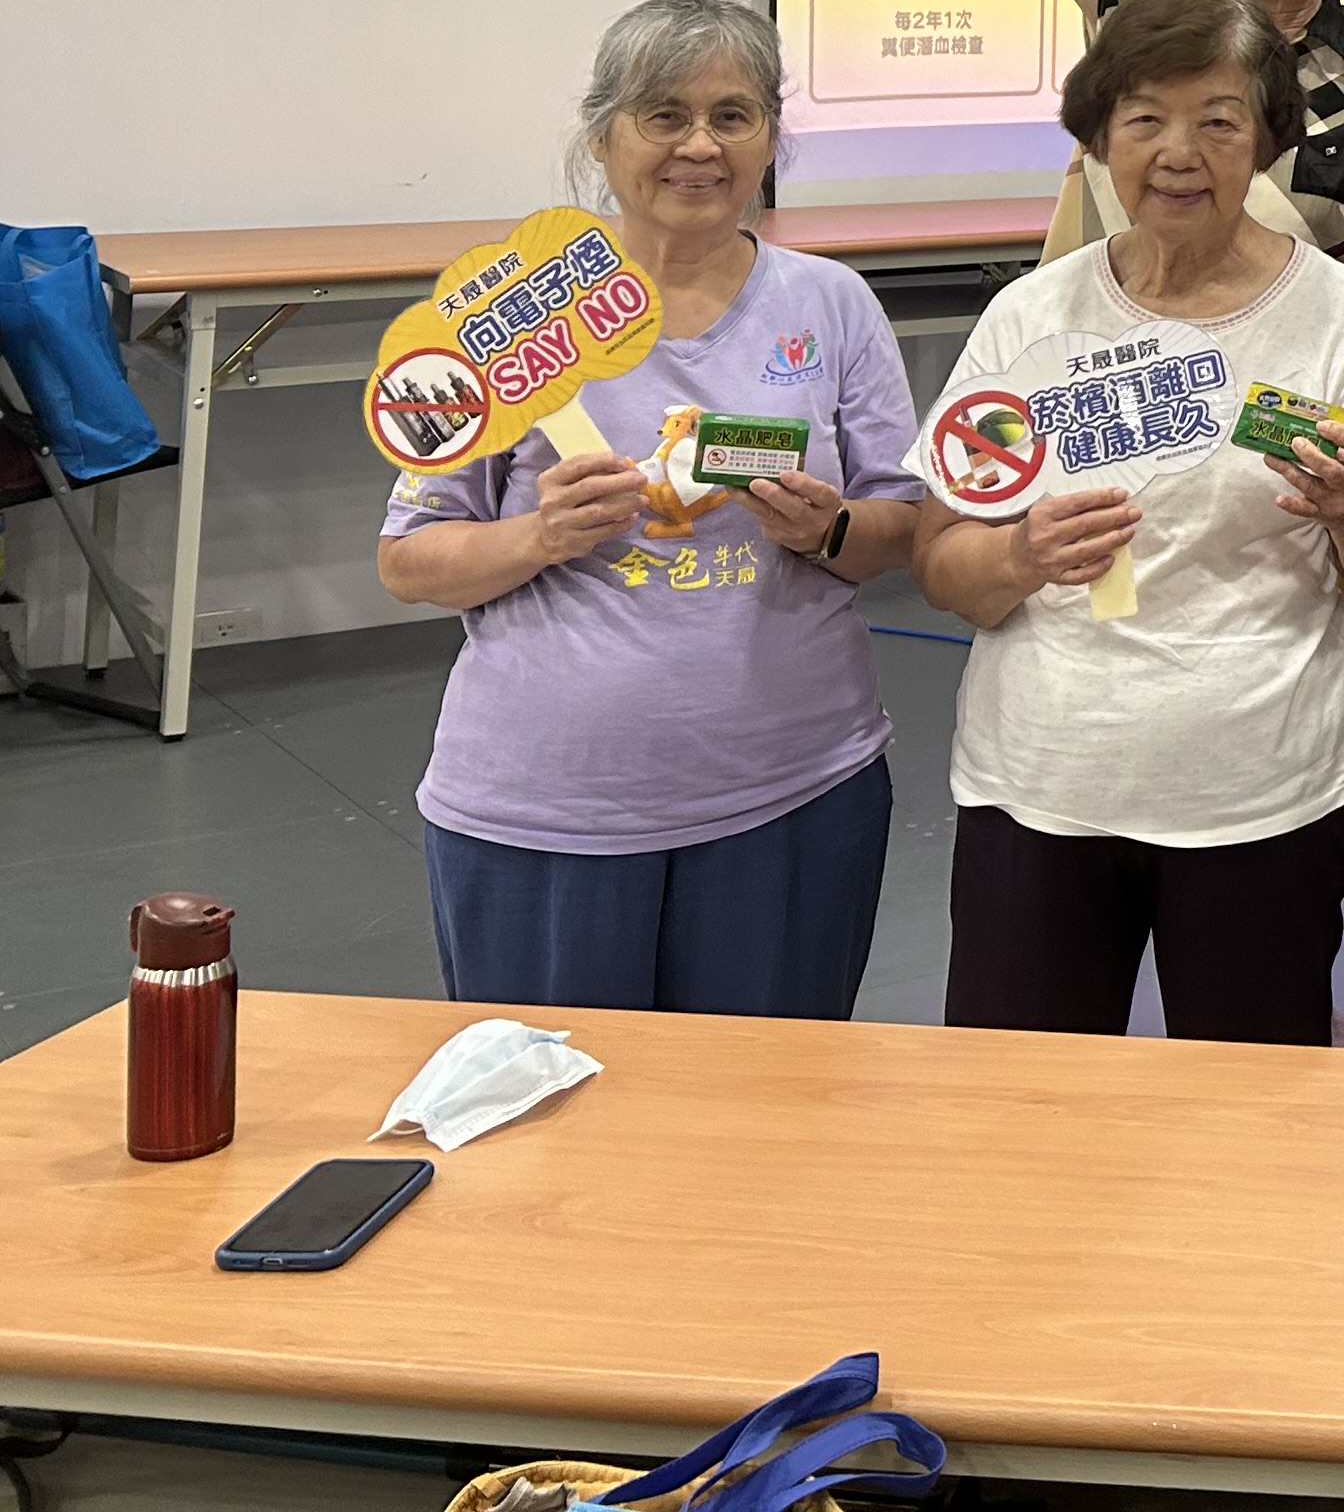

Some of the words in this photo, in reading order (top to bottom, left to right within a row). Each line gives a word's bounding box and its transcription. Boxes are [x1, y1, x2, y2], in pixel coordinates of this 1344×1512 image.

[894, 11, 972, 30] 每2年1次
[437, 249, 526, 320] 天晟醫院
[456, 227, 623, 366] 向電子煙
[486, 316, 581, 404] SAY
[579, 270, 651, 344] NO
[1066, 337, 1161, 376] 天晟醫院
[1027, 348, 1226, 435] 菸檳酒離口
[715, 427, 794, 449] 水晶肥皂
[1058, 396, 1221, 474] 健康長久
